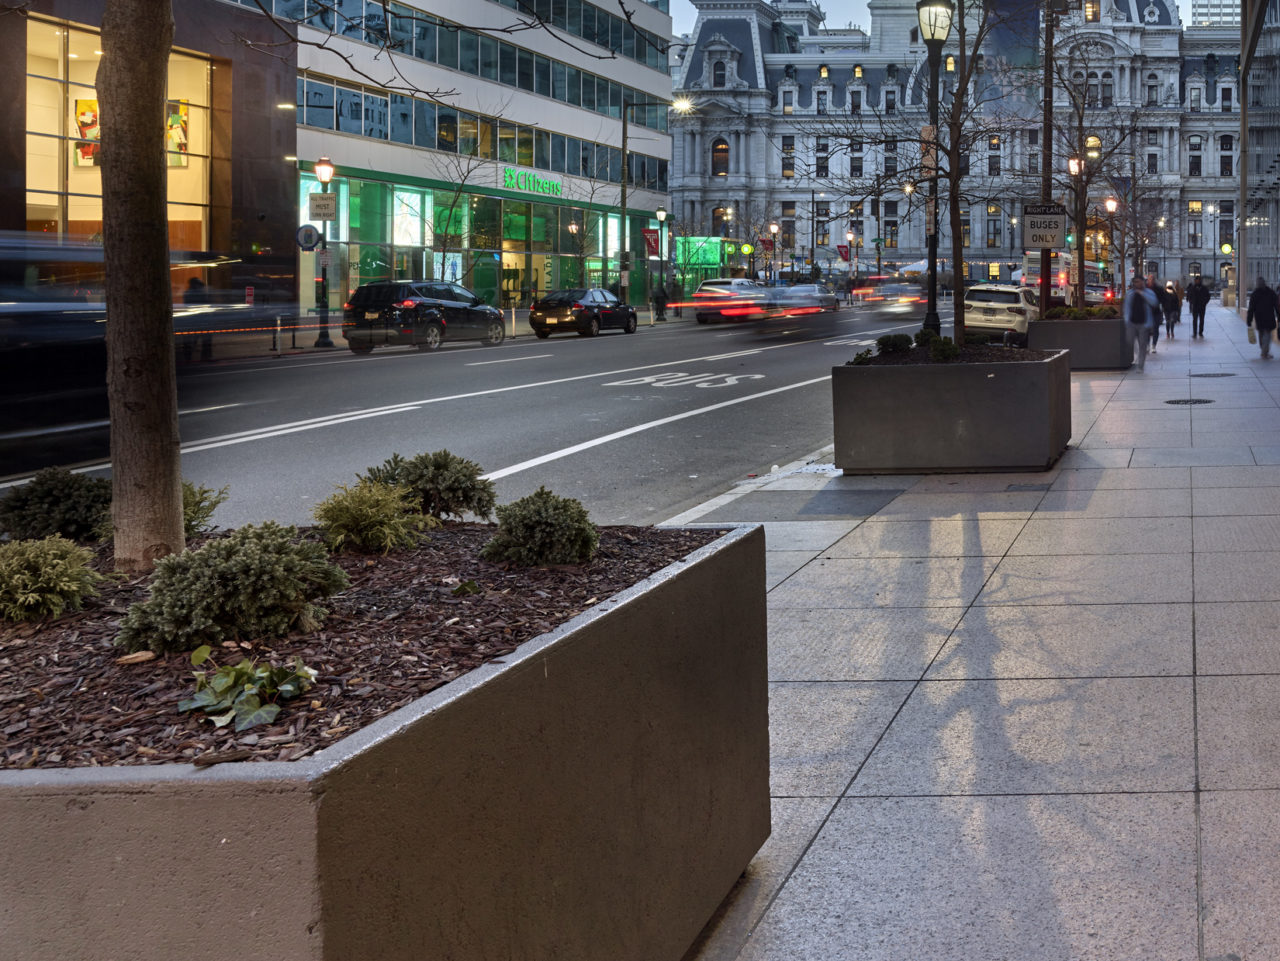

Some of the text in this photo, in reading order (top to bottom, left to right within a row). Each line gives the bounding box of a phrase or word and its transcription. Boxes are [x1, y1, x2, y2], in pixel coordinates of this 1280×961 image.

[517, 171, 562, 195] Citizens
[1030, 220, 1059, 229] BUSES
[1031, 233, 1057, 243] ONLY
[601, 372, 766, 388] BUS
